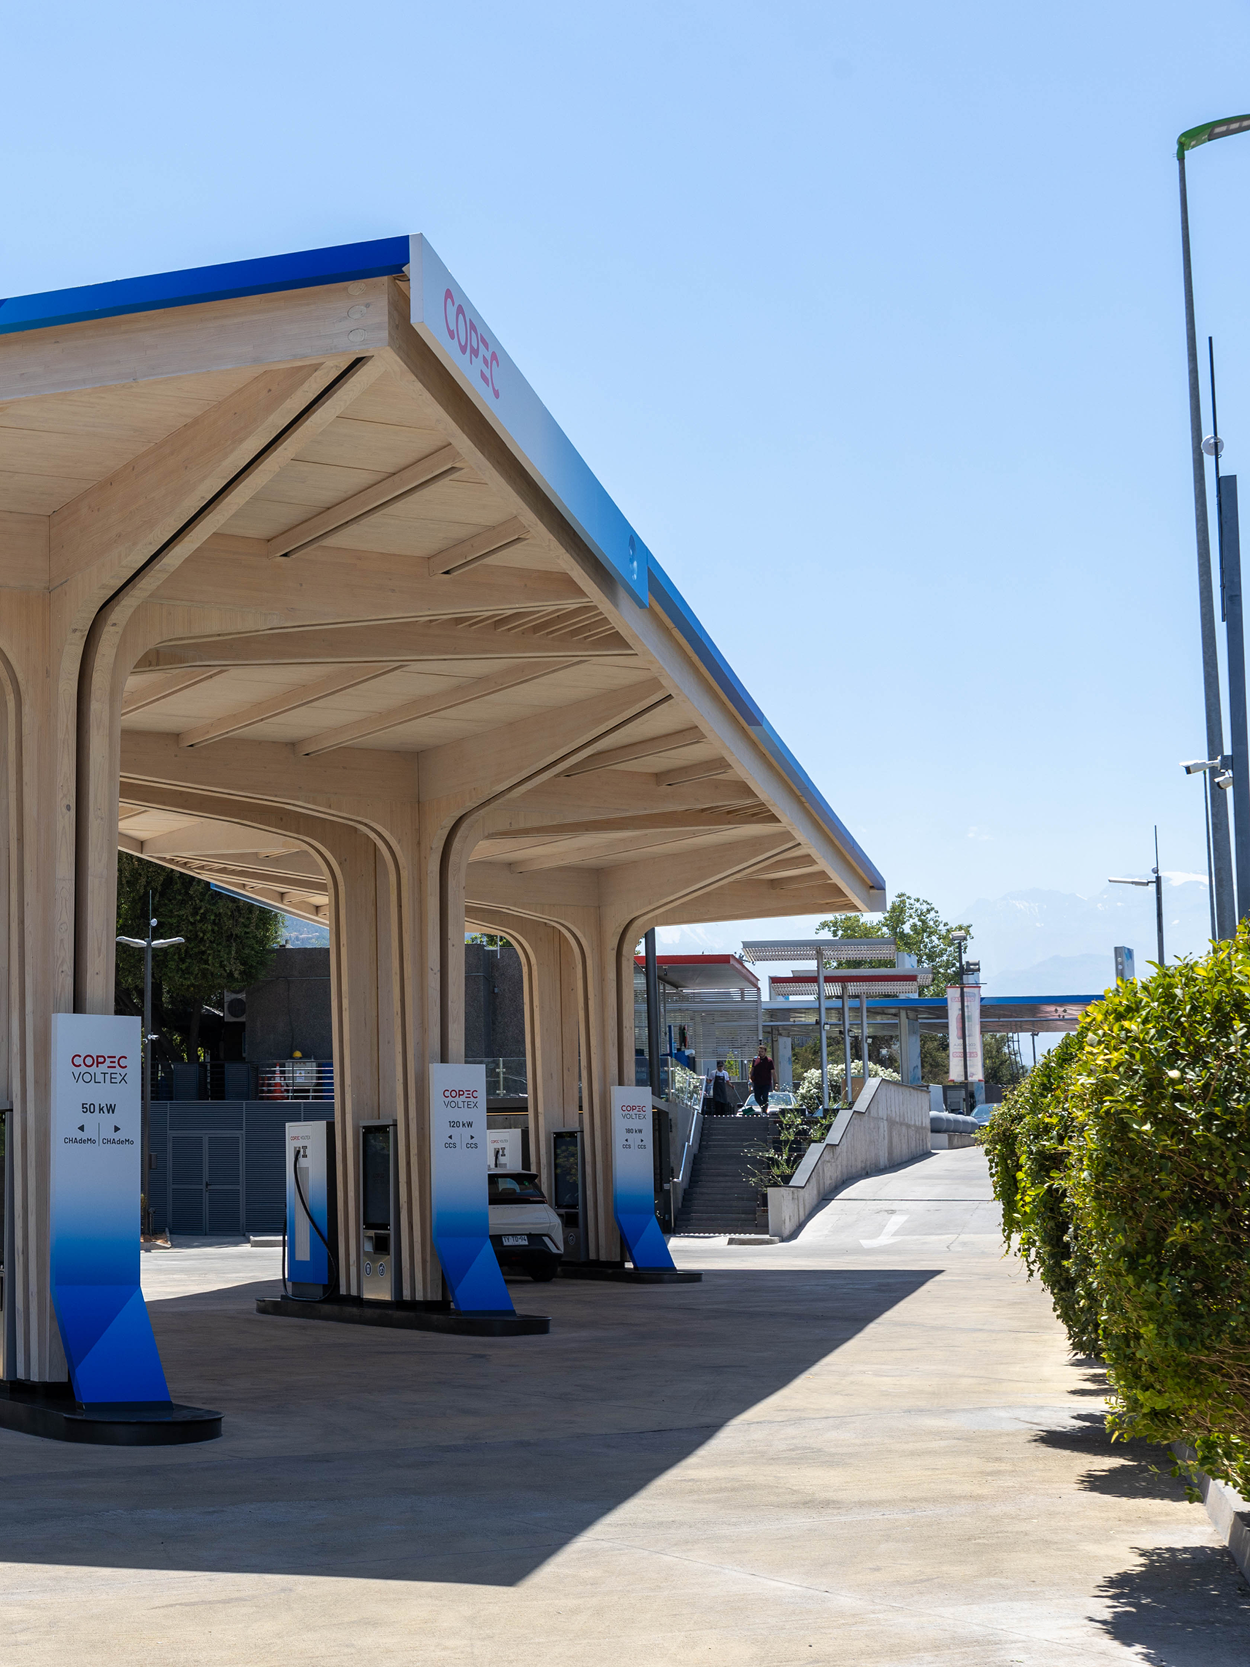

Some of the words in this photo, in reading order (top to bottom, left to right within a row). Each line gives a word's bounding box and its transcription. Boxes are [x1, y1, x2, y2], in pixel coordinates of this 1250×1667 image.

[444, 288, 500, 400] COPEC
[71, 1054, 128, 1069] COPEC
[71, 1071, 128, 1084] VOLTEX
[442, 1089, 479, 1099] COPEC
[81, 1103, 96, 1114] 50
[98, 1103, 116, 1114] kW
[443, 1100, 479, 1109] VOLTEX
